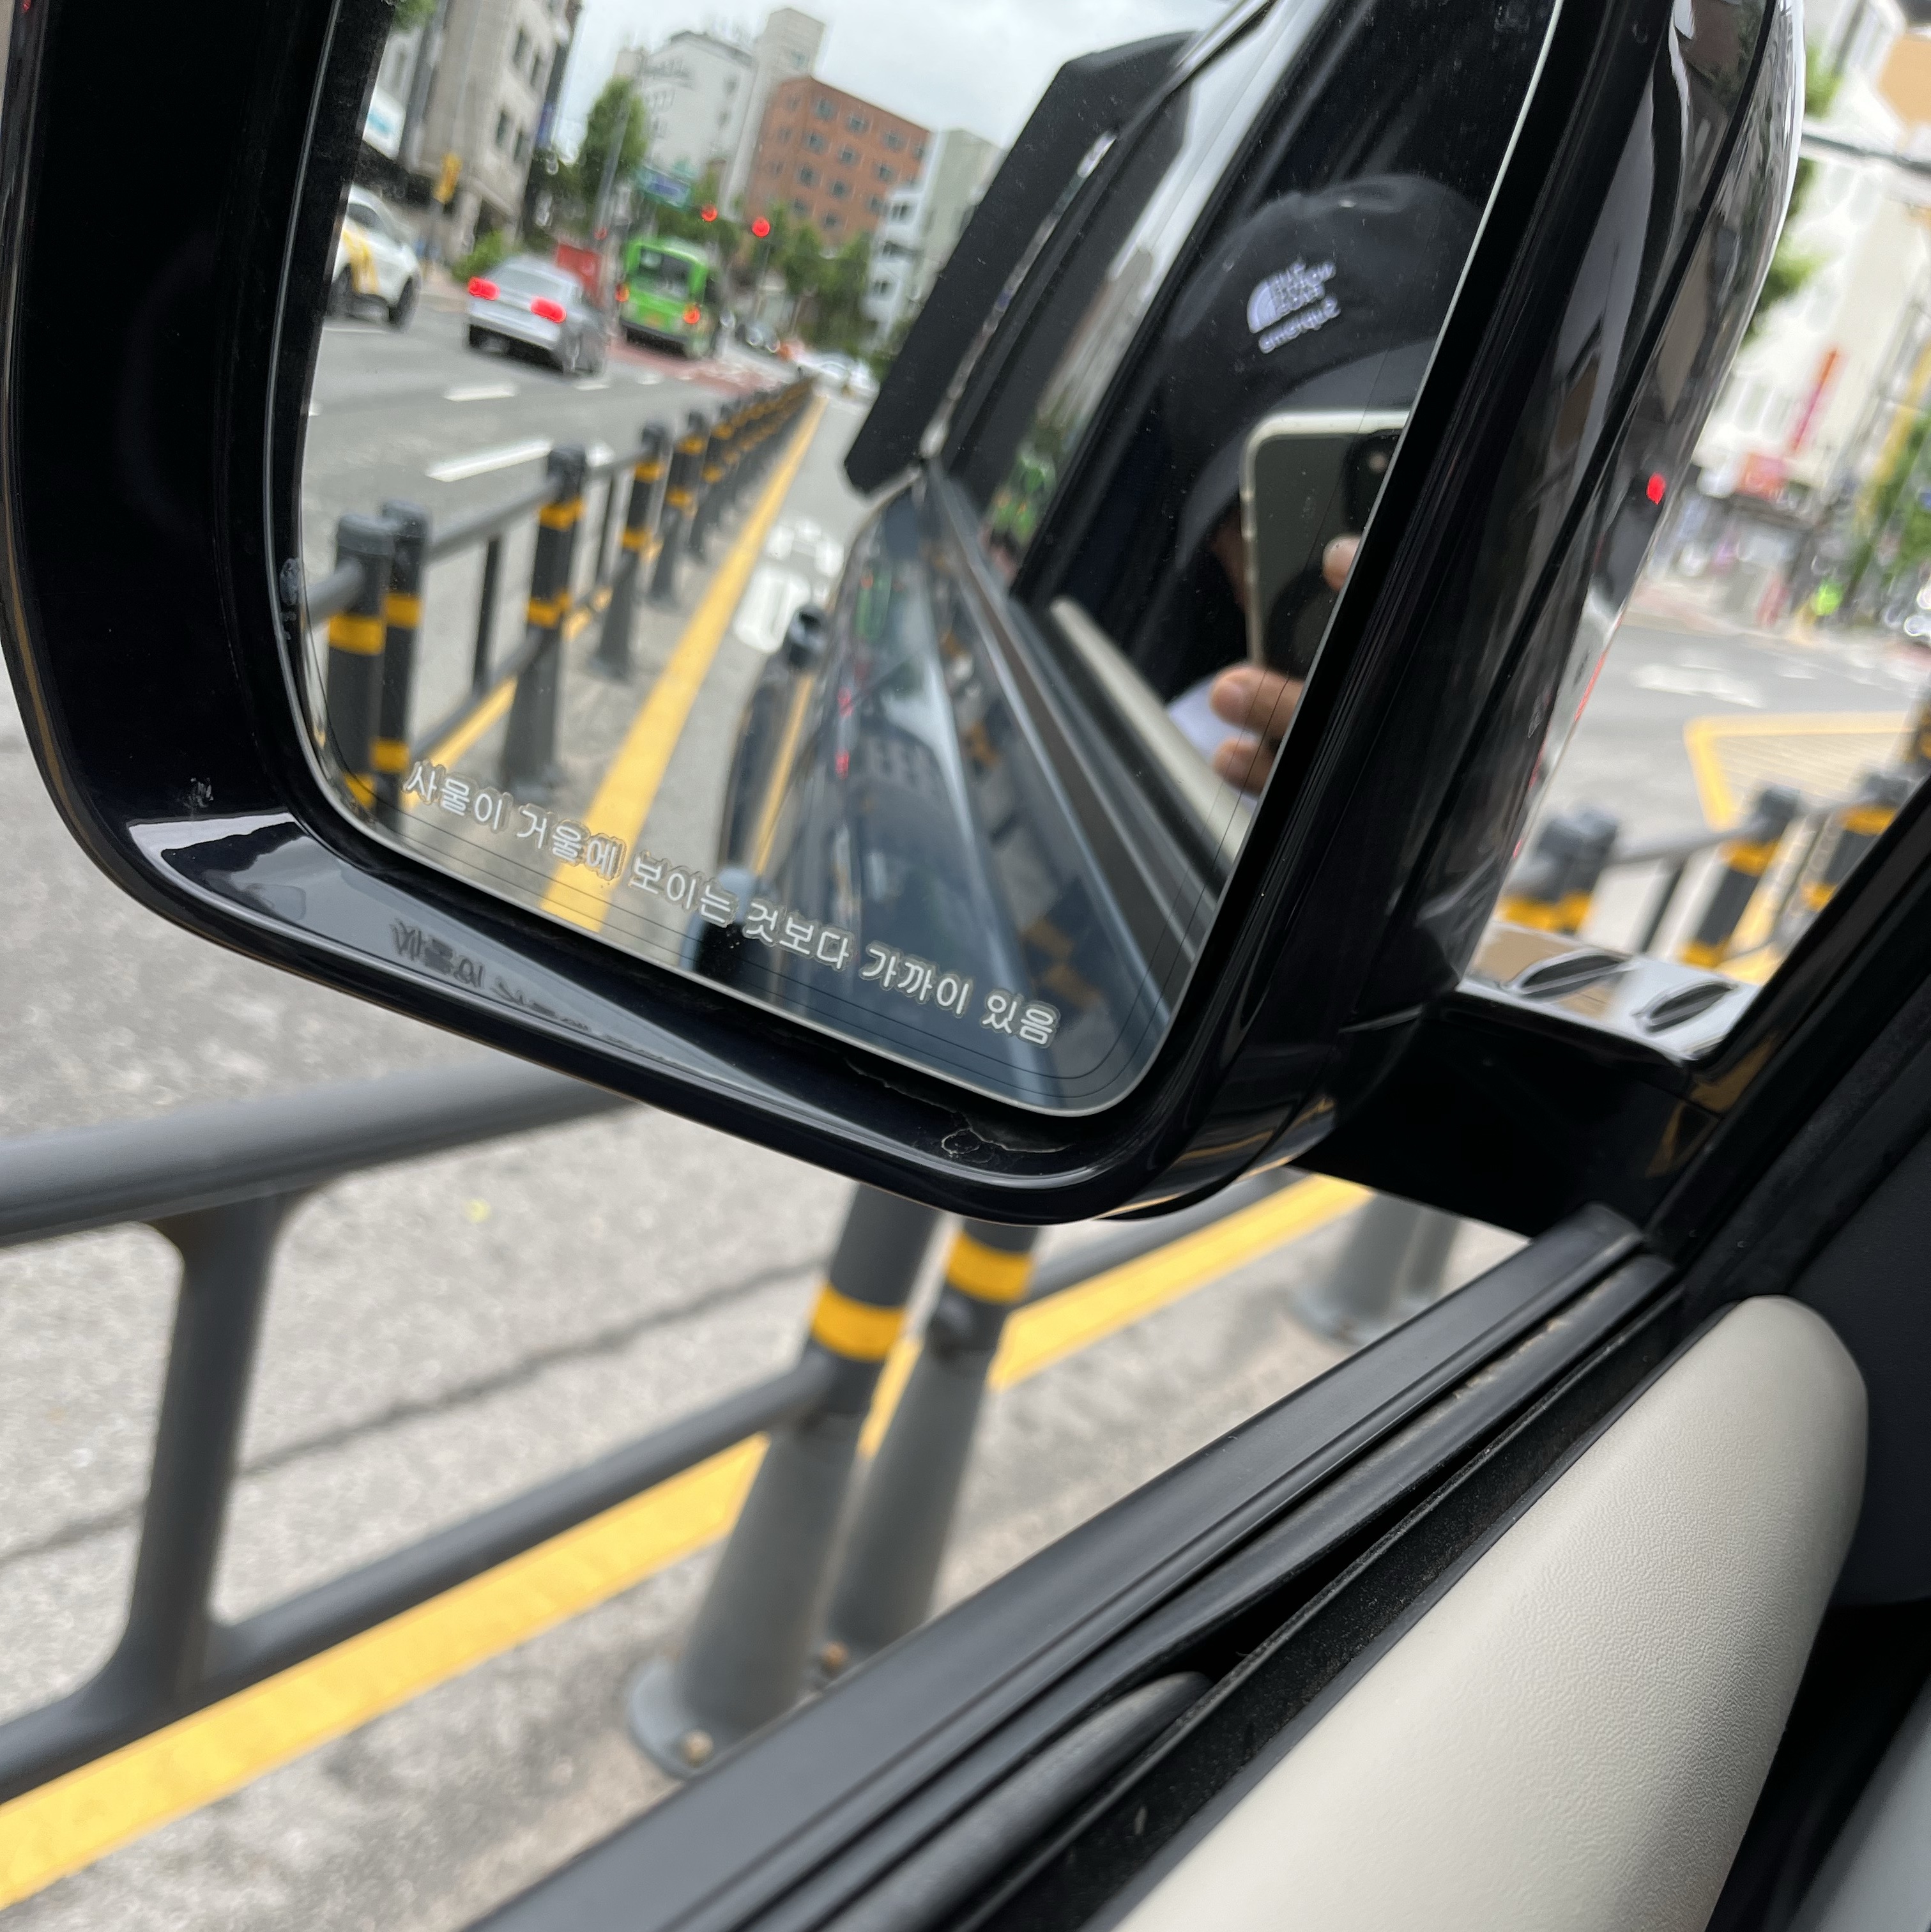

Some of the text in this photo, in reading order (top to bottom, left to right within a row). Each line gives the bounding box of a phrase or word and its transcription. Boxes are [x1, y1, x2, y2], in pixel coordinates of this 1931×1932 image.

[404, 763, 1056, 1046] 사물이 거울에 보이는 것보다 가까이 있음
